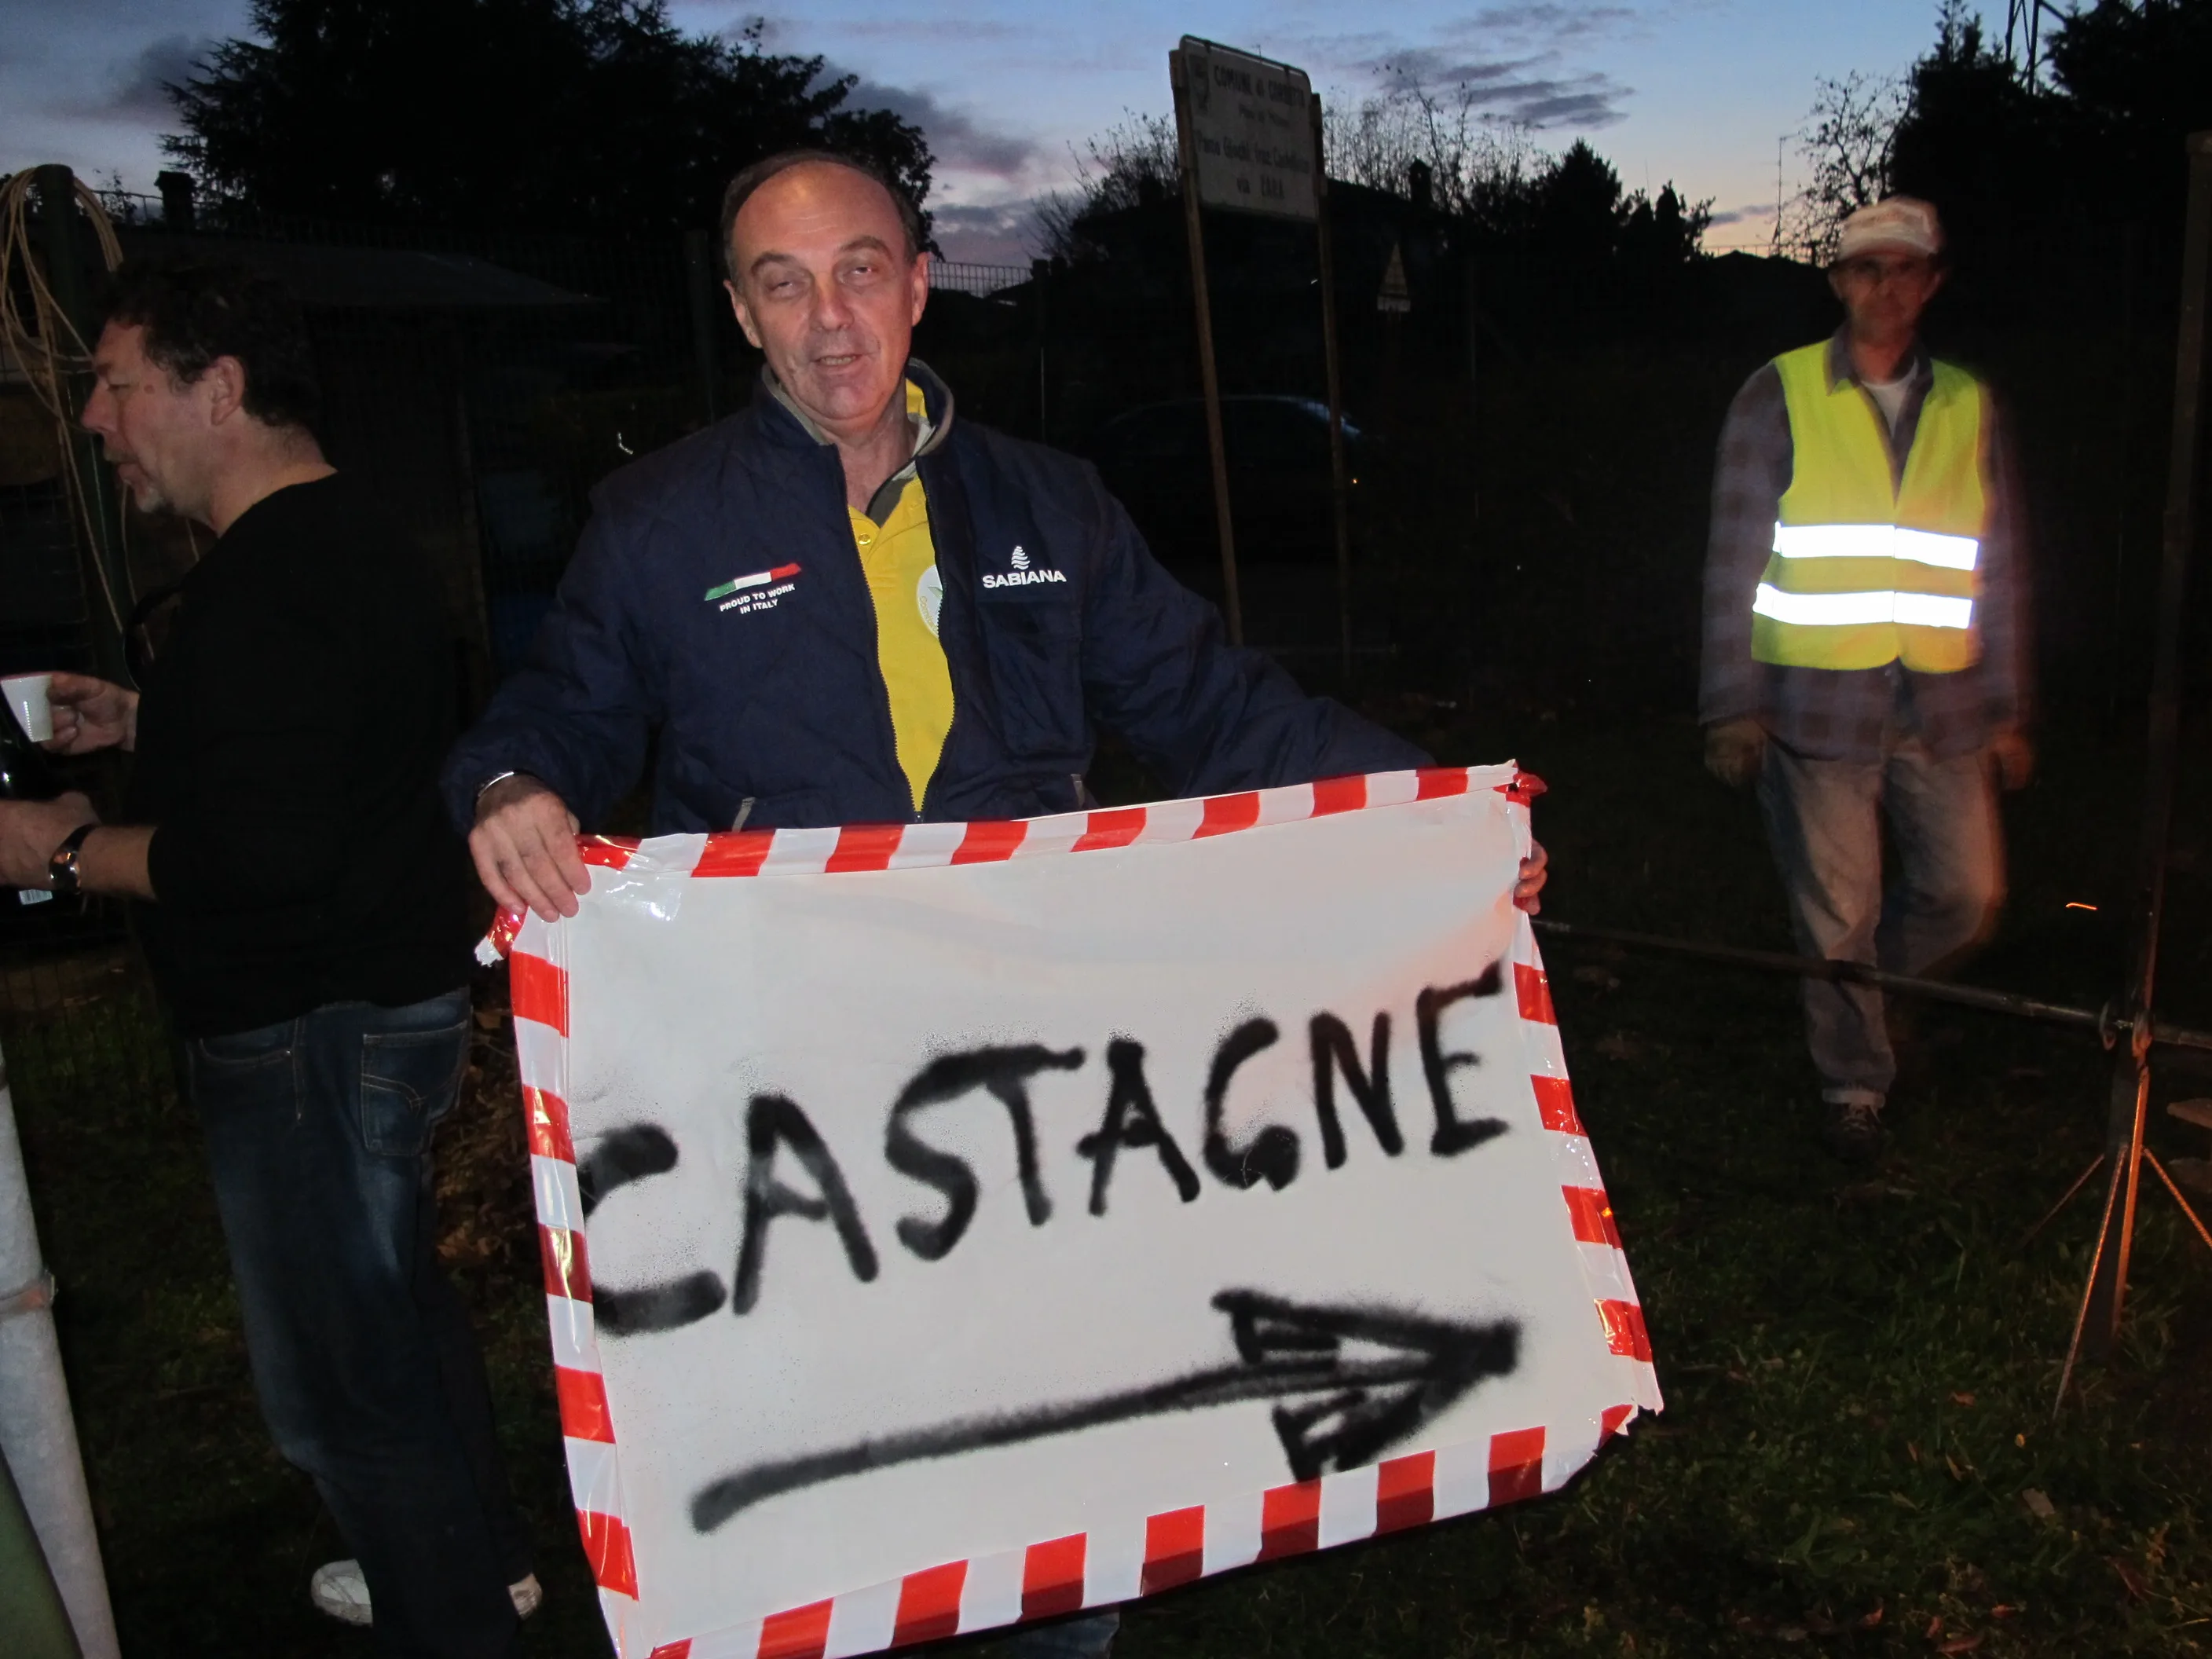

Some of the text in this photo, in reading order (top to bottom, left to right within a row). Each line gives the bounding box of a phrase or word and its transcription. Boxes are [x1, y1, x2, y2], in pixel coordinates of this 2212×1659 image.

[983, 570, 1067, 588] SABIANA
[720, 595, 751, 612] PROUD
[767, 584, 796, 597] WORK
[740, 599, 778, 614] IN ITALY
[573, 961, 1511, 1337] CASTAGNE
